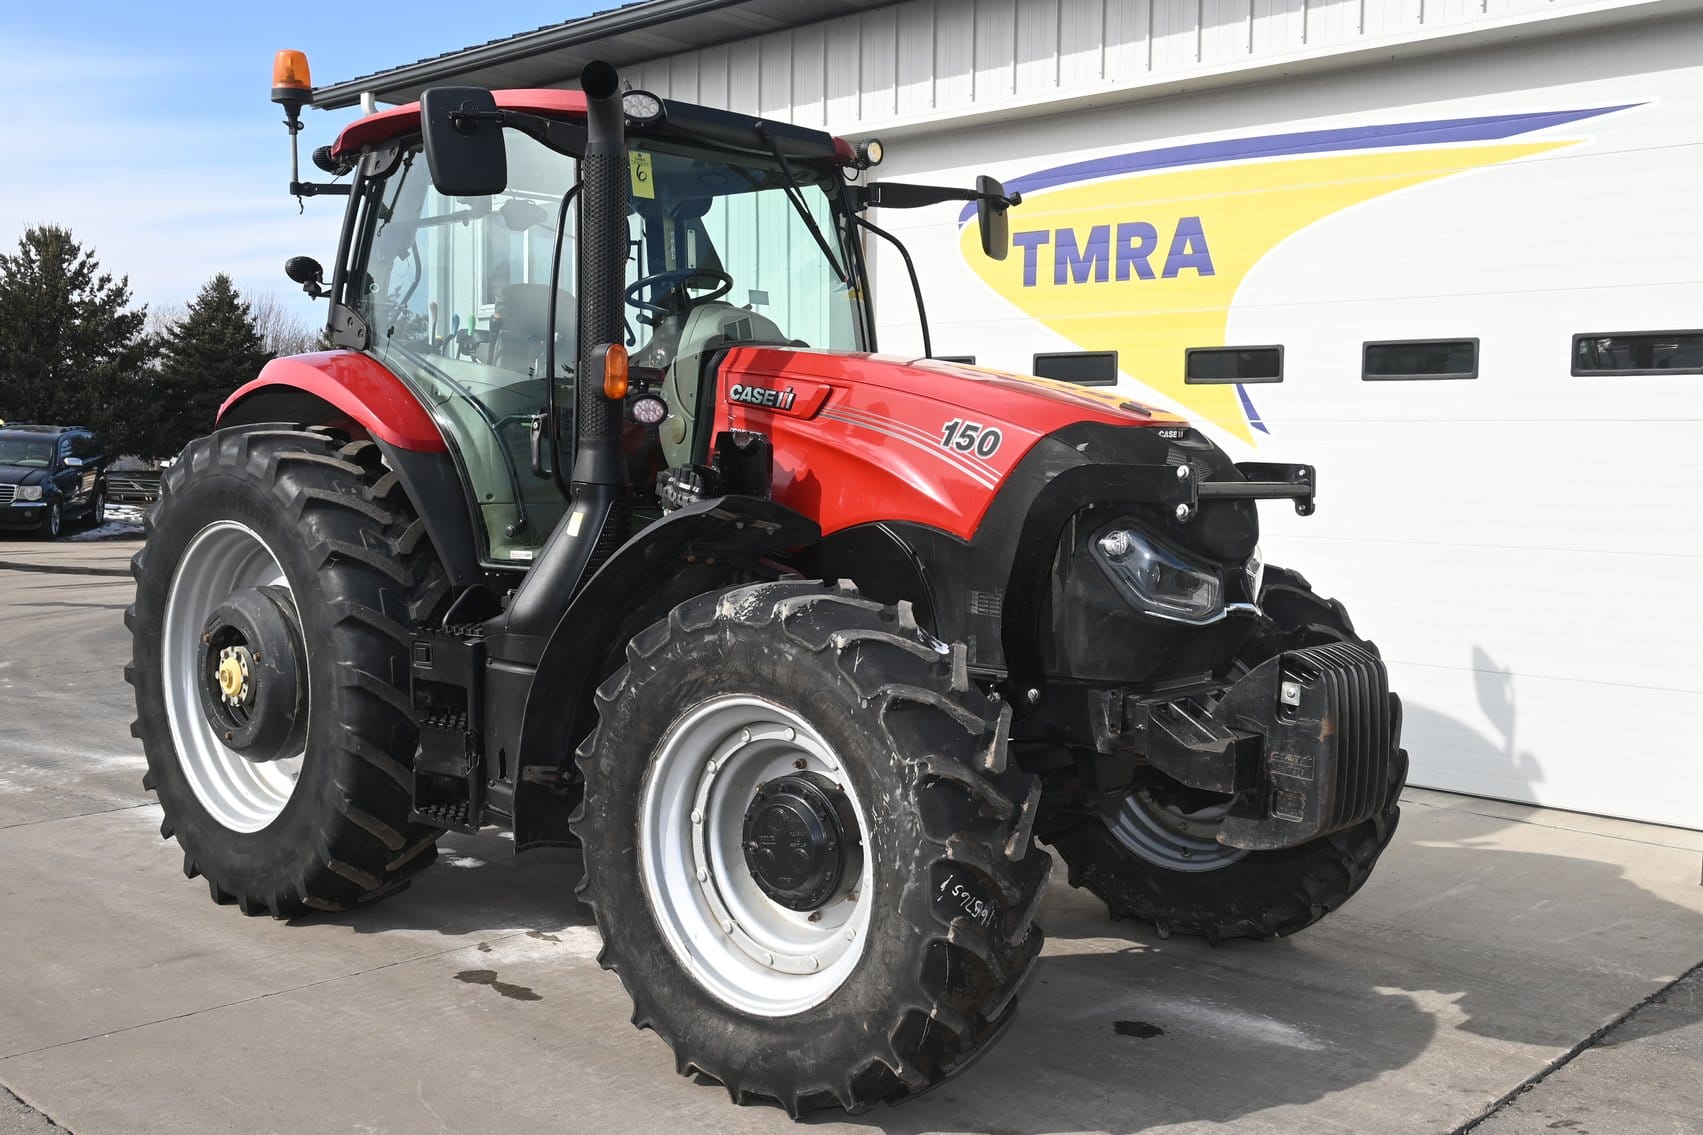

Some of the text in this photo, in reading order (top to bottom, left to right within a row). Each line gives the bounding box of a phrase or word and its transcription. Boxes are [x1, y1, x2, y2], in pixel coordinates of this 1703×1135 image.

[636, 164, 648, 182] 6
[1012, 216, 1216, 287] TMRA
[729, 384, 777, 406] CASE
[941, 418, 1003, 460] 150
[1158, 430, 1177, 438] CASE
